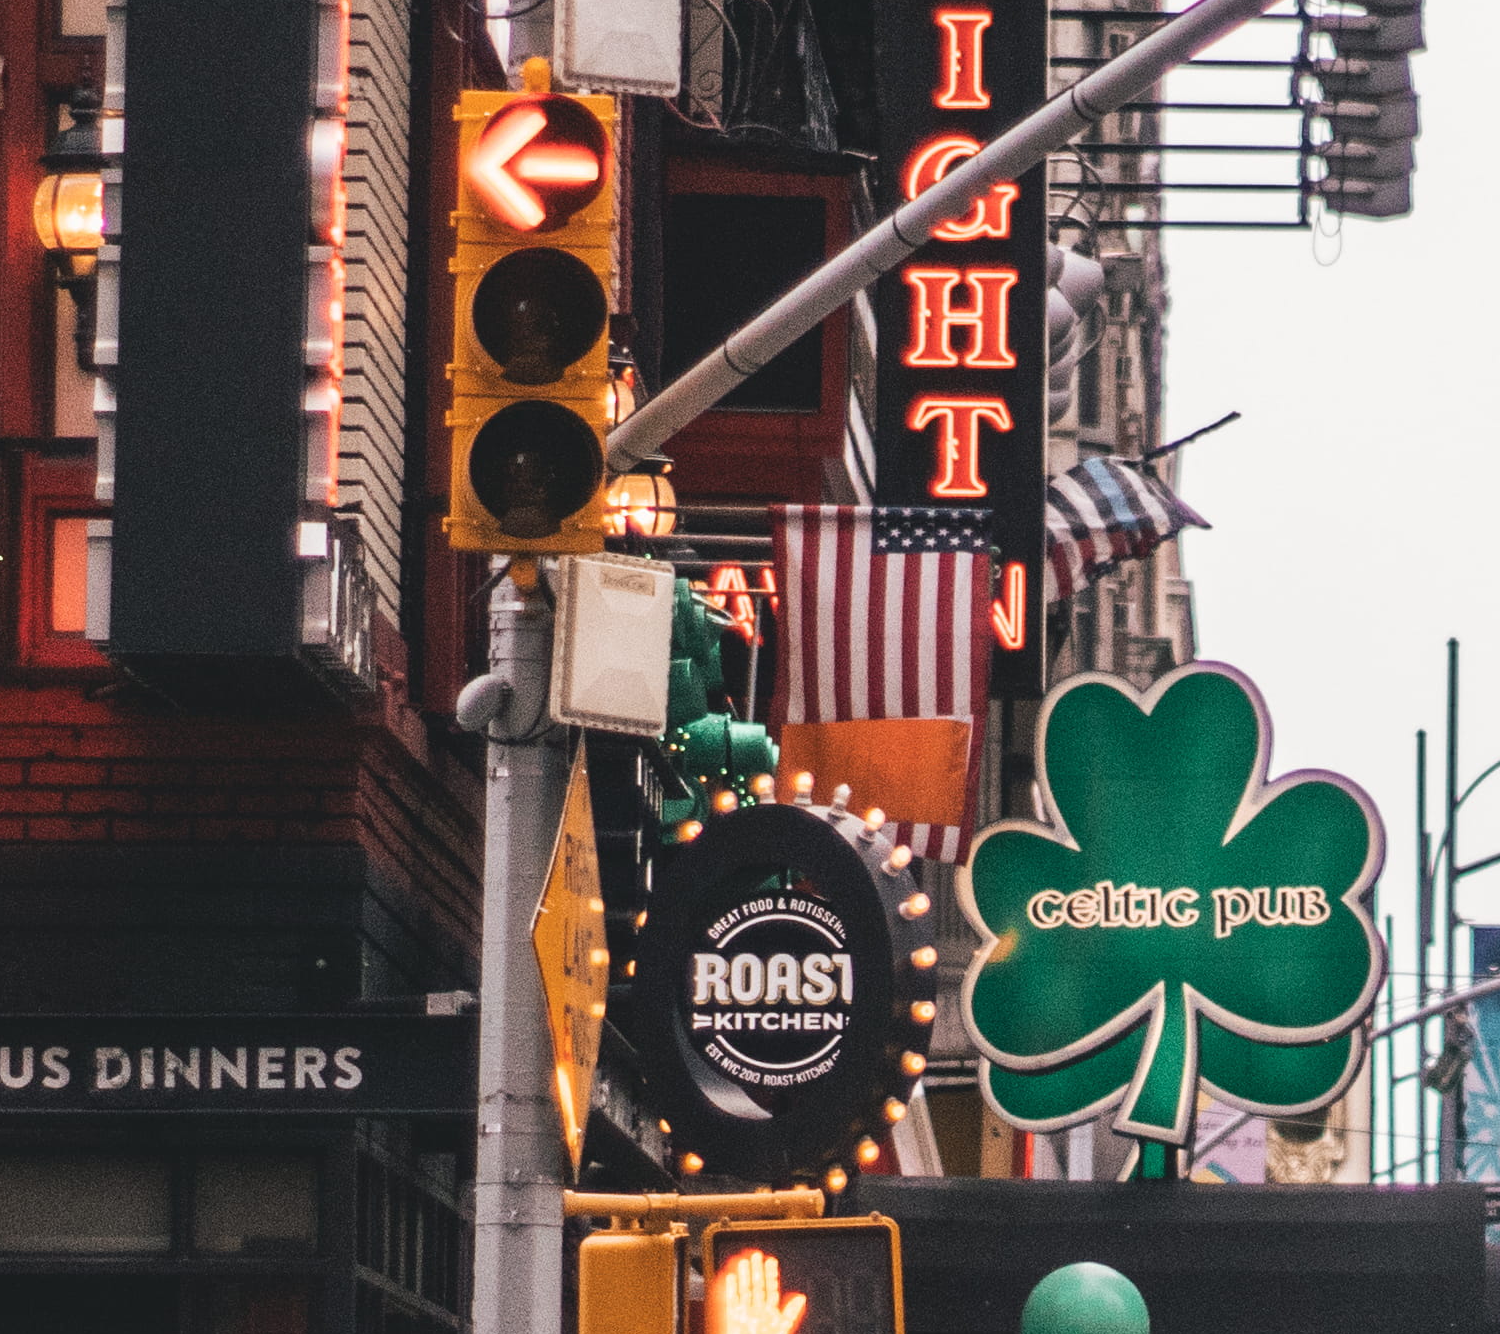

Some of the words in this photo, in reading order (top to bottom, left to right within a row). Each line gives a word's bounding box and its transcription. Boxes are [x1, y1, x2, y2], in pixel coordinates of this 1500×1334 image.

[707, 908, 741, 940] GREAT
[741, 897, 774, 917] FOOD
[777, 897, 787, 911] &
[713, 1012, 844, 1030] KITCHEN
[94, 1045, 364, 1091] DINNERS
